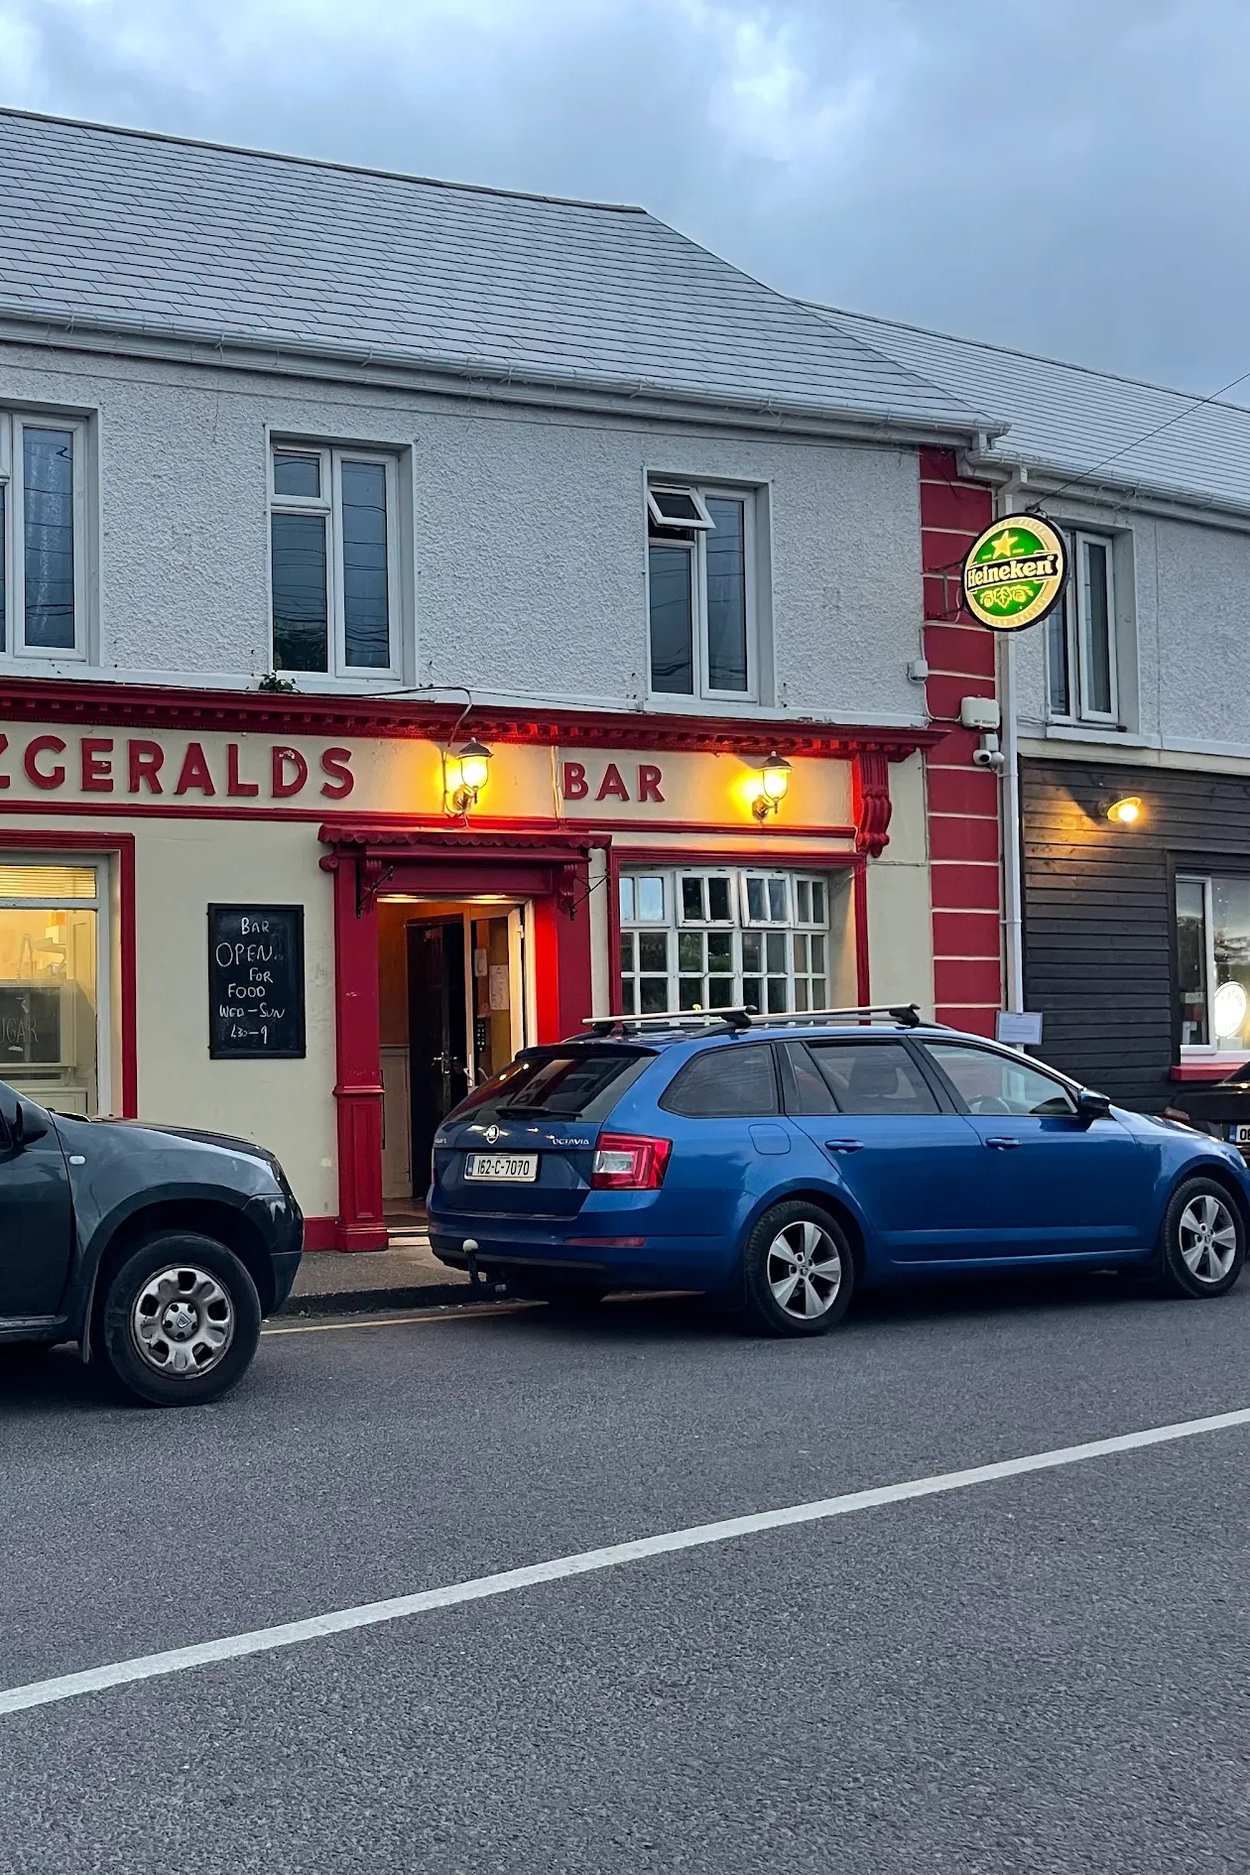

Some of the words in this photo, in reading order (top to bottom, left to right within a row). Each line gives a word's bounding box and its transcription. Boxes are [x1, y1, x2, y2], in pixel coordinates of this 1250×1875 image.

[967, 559, 1053, 588] Heineken
[562, 761, 666, 803] BAR
[241, 917, 270, 935] BAR
[228, 983, 266, 999] FOOD
[477, 1159, 530, 1176] 162-C-7070
